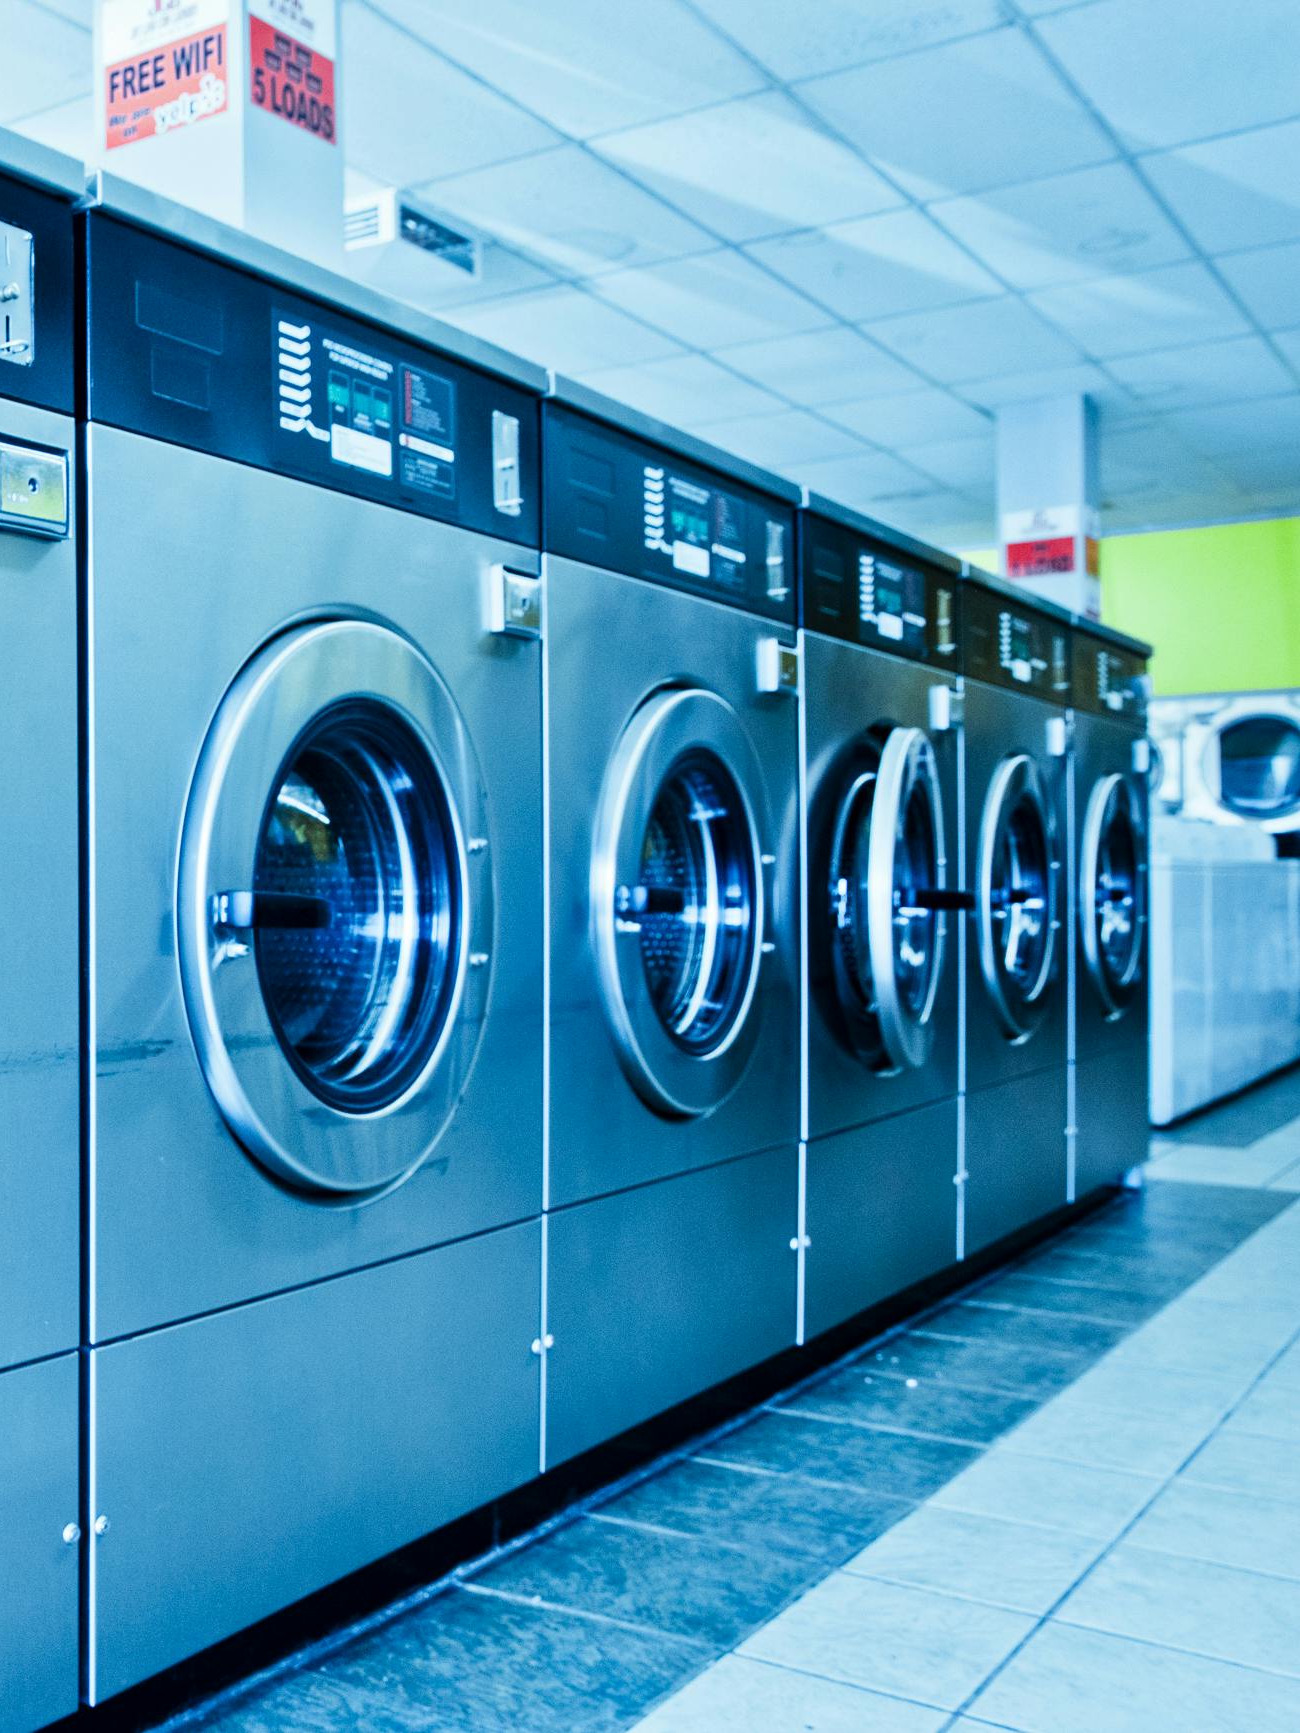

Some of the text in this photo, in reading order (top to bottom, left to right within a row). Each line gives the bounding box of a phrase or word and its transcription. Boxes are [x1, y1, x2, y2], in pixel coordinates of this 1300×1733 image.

[110, 33, 222, 103] FREE WIFI
[254, 67, 333, 138] 5 LOADS
